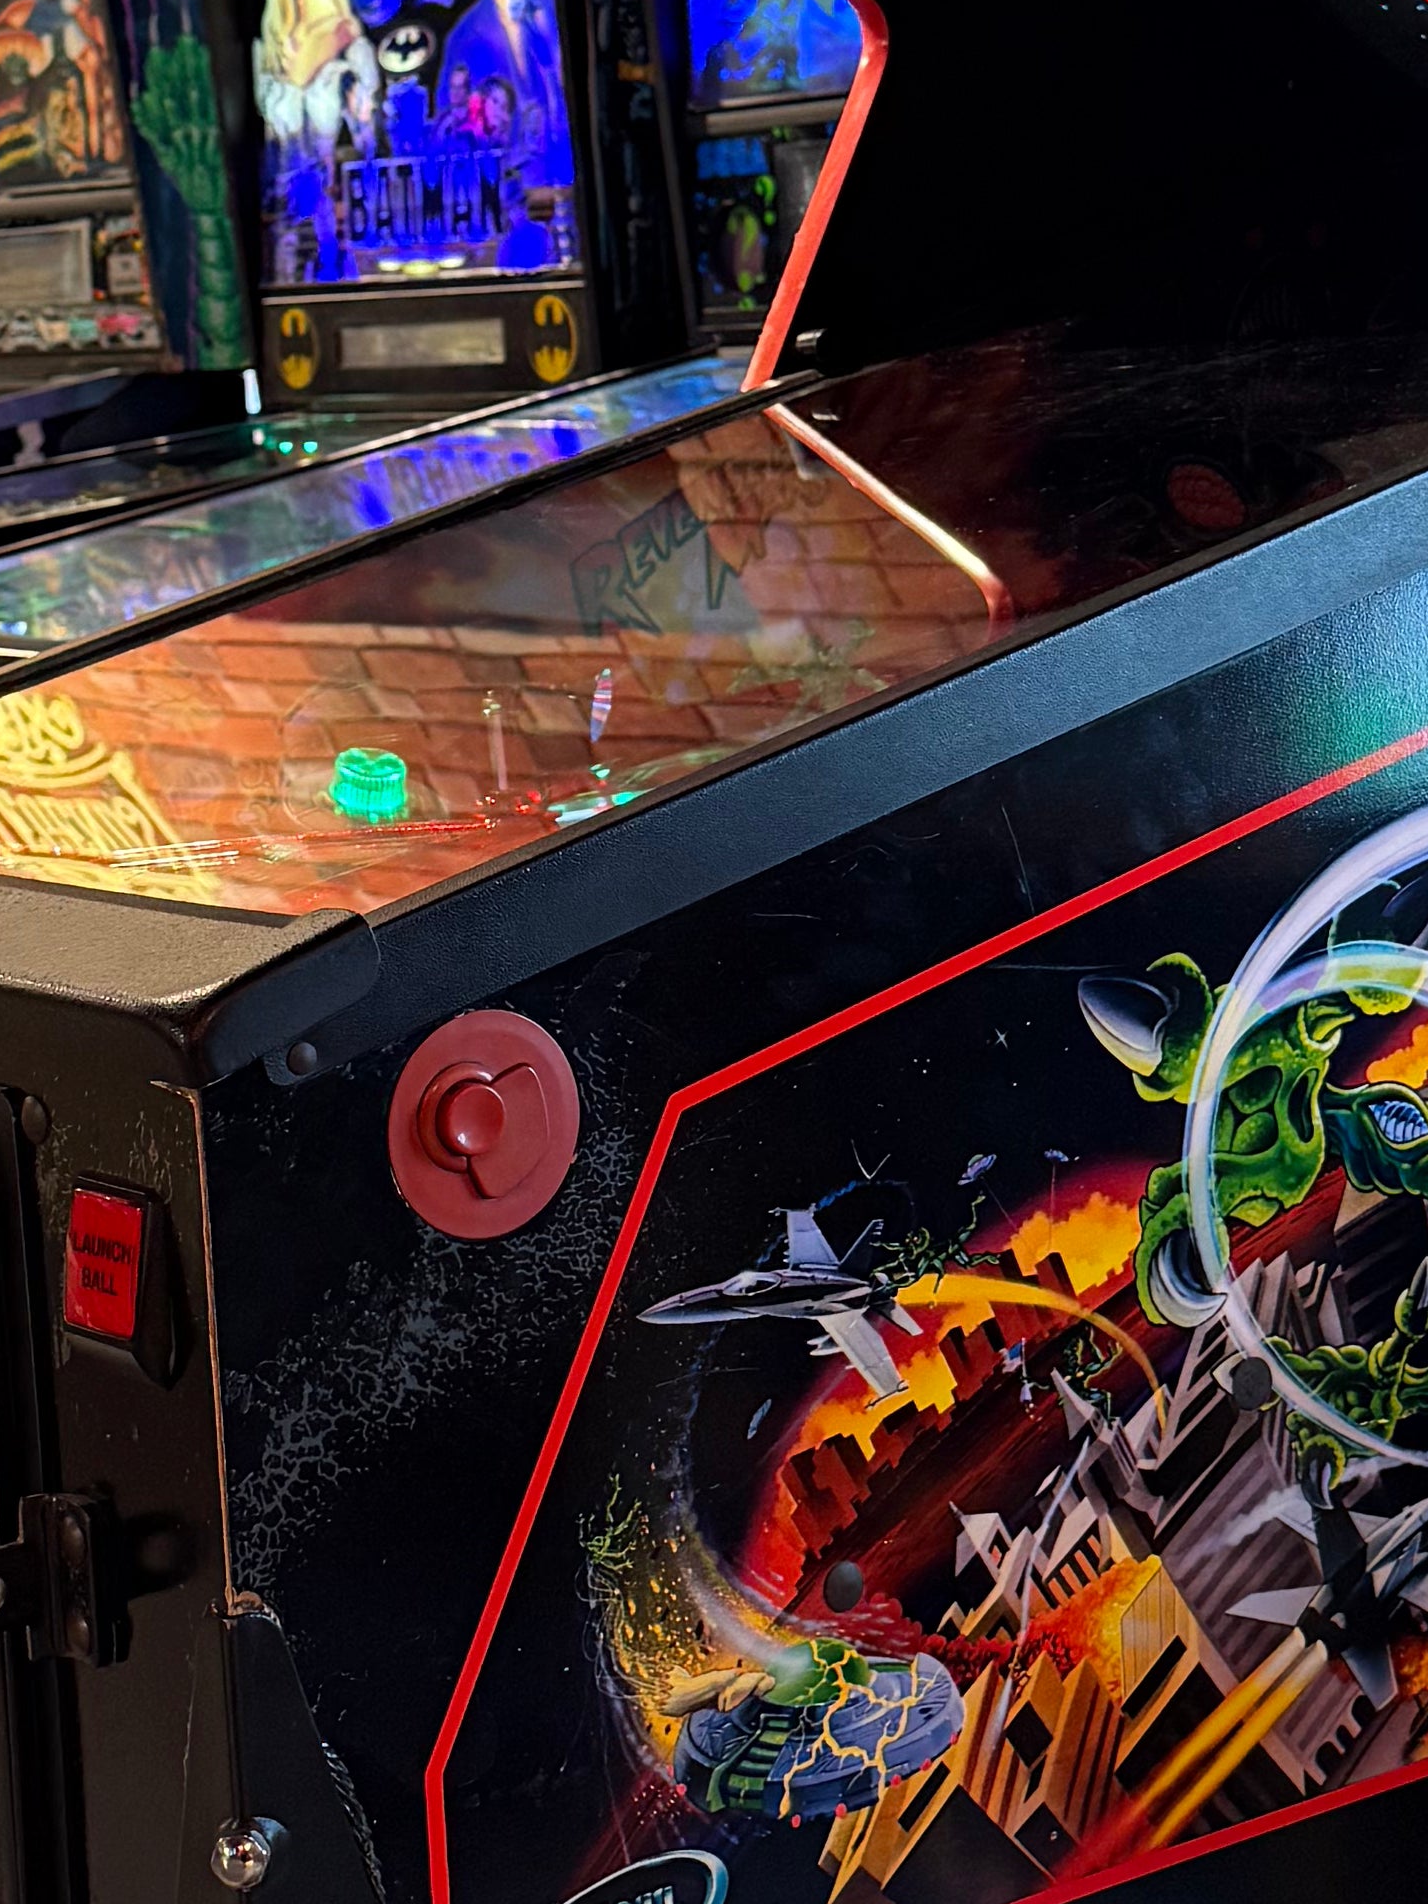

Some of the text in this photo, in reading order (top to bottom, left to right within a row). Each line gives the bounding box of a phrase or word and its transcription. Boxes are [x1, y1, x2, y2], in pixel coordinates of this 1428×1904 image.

[341, 149, 504, 247] BATMAN
[72, 1232, 132, 1265] LAUNCH
[81, 1266, 118, 1296] BALL
